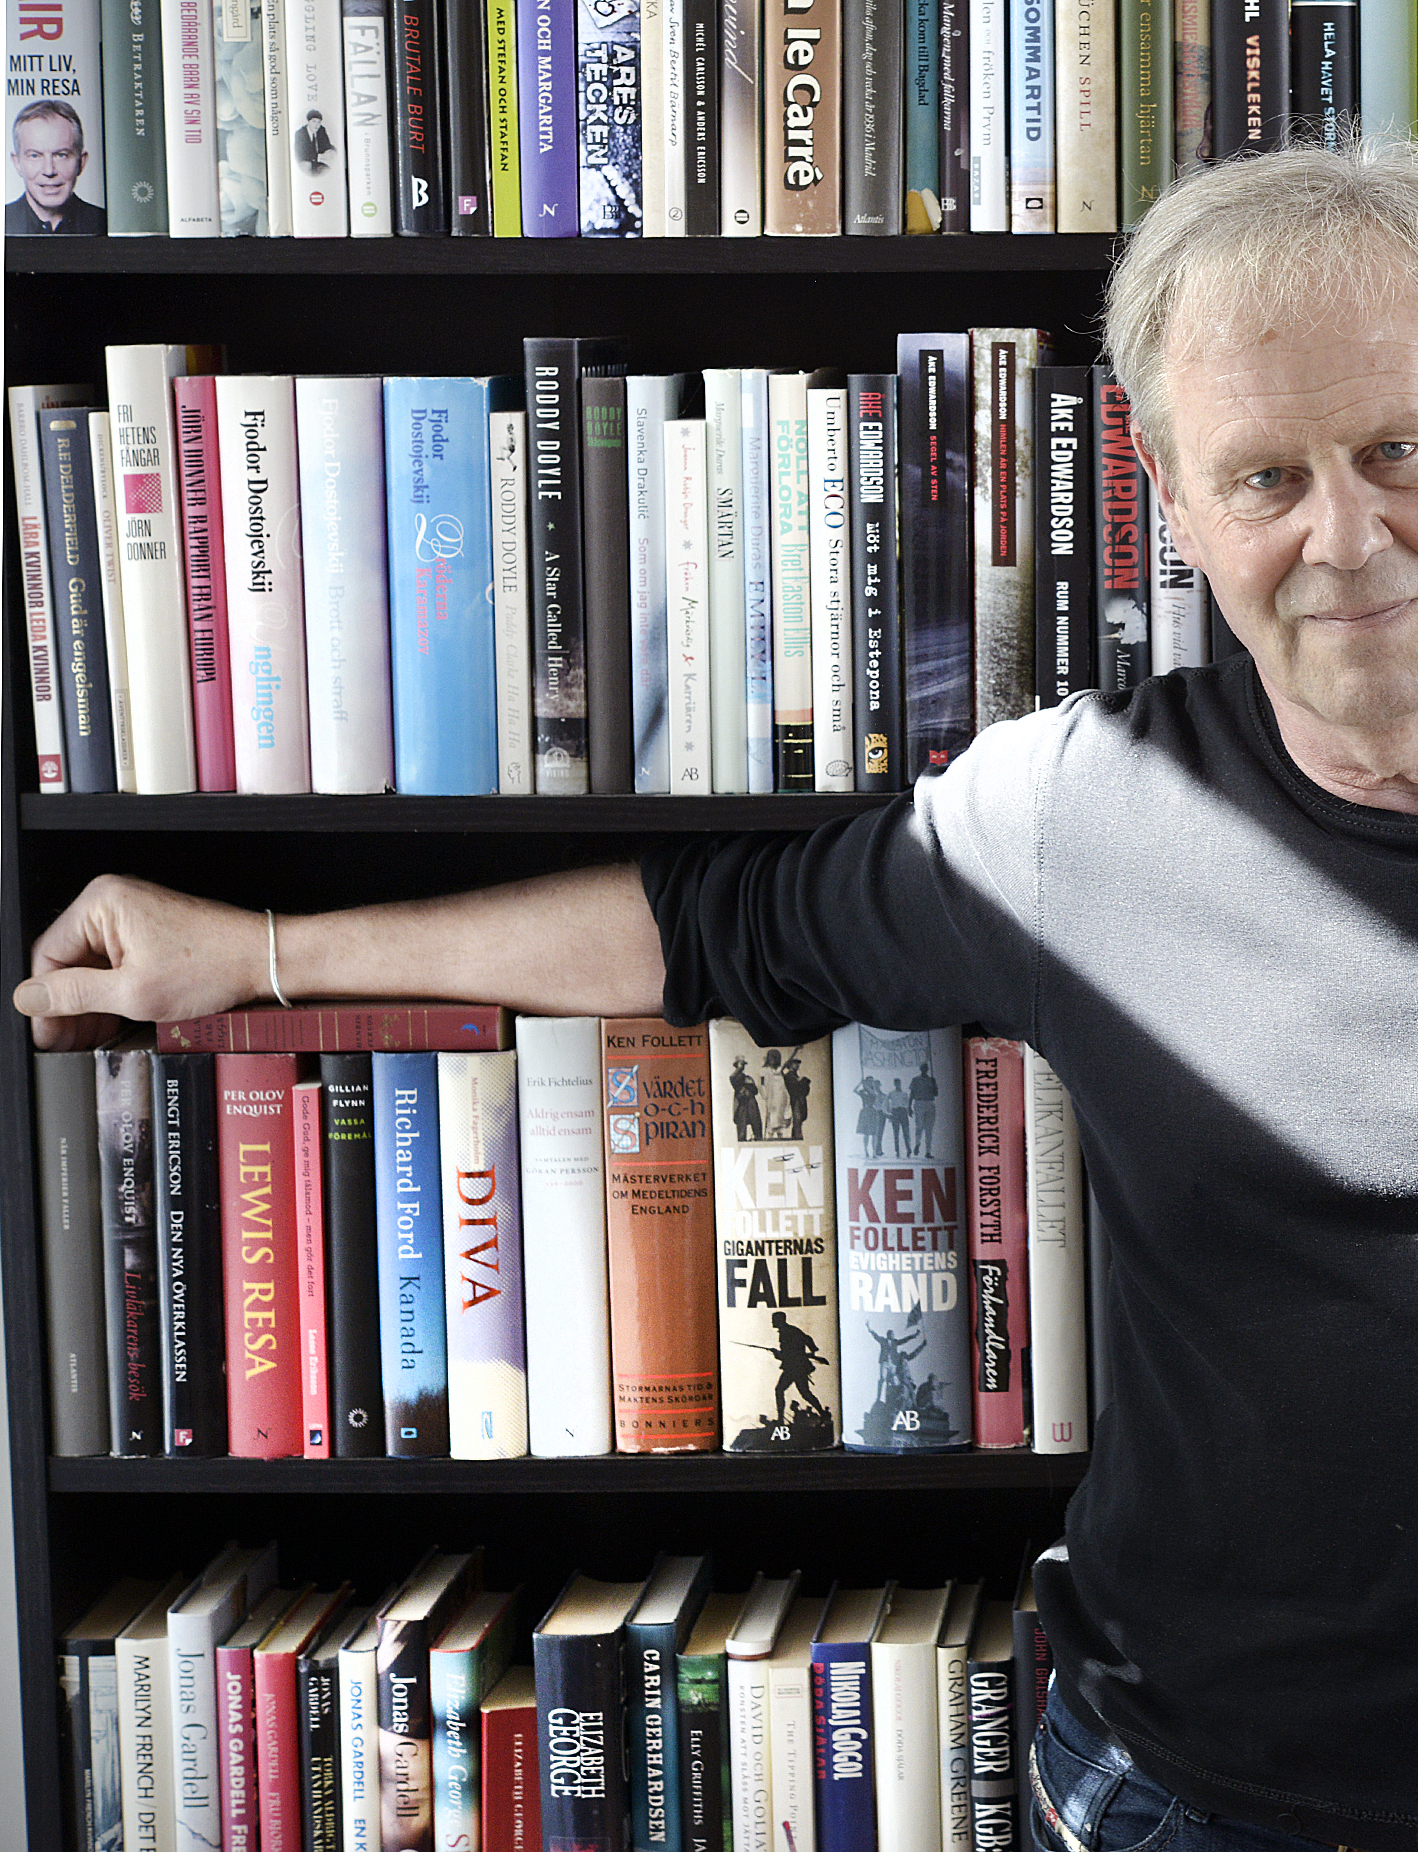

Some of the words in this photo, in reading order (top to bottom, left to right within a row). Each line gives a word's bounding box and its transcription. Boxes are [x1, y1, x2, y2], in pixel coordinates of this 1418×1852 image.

[496, 7, 505, 36] MED
[536, 18, 551, 51] OCH
[9, 54, 44, 72] MITT
[50, 54, 76, 74] LIV,
[347, 24, 382, 127] FÄLLAN
[403, 14, 422, 97] BRUTALE
[496, 38, 506, 84] STEFAN
[695, 56, 706, 96] CARLSSON
[785, 27, 822, 71] le
[1139, 12, 1151, 97] ensamma
[8, 79, 35, 96] MIN
[41, 79, 81, 96] RESA
[183, 92, 200, 107] AV
[498, 88, 507, 114] OCH
[537, 55, 553, 154] MARGARITA
[583, 42, 609, 167] TECKEN
[612, 44, 638, 125] ARES
[1079, 77, 1091, 131] SPILL
[1246, 34, 1262, 140] VISKLEKEN
[184, 109, 201, 126] SIN
[184, 129, 202, 144] TID
[407, 103, 425, 154] BURT
[499, 117, 509, 172] STAFFAN
[696, 110, 706, 141] ANDERS
[784, 73, 824, 192] Carré
[1136, 103, 1157, 166] hjärtan
[697, 146, 707, 184] ERICSSON
[117, 404, 133, 423] FRI
[534, 366, 560, 430] RODDY
[859, 391, 886, 418] ÅKE
[1050, 392, 1083, 433] ÅKE
[119, 426, 157, 445] HETENS
[120, 446, 161, 468] FÅNGAR
[239, 409, 266, 474] Fjodor
[409, 408, 431, 505] Dostojevskij
[430, 408, 450, 461] Fjodor
[824, 396, 842, 473] Umberto
[536, 440, 562, 500] DOYLE
[859, 421, 884, 504] EDWARDSON
[717, 487, 737, 559] SMÄRTAN
[823, 476, 845, 530] ECO
[1050, 437, 1078, 556] EDWARDSON
[21, 515, 42, 547] LÄRA
[126, 515, 152, 539] JÖRN
[127, 541, 167, 561] DONNER
[246, 477, 273, 594] Dostojevskij
[24, 551, 45, 609] KVINNOR
[544, 551, 561, 562] A
[544, 566, 561, 599] Star
[828, 538, 845, 585] Stora
[864, 563, 882, 598] mig
[68, 577, 88, 617] Gud
[415, 566, 430, 656] Karamazov
[868, 606, 882, 618] i
[1055, 581, 1069, 611] RUM
[29, 611, 48, 642] LEDA
[71, 618, 88, 637] är
[546, 603, 562, 652] Called
[825, 591, 843, 660] stjärnor
[1055, 615, 1070, 676] NUMMER
[32, 645, 52, 703] KVINNOR
[71, 640, 93, 738] engelsman
[546, 655, 564, 703] Henry
[830, 664, 846, 694] och
[865, 627, 882, 712] Estepona
[1056, 680, 1070, 697] 10
[831, 698, 846, 733] små
[607, 1036, 636, 1047] KEN
[642, 1034, 704, 1047] FOLLETT
[166, 1079, 179, 1127] BENGT
[223, 1090, 246, 1101] PER
[249, 1089, 284, 1101] OLOV
[226, 1103, 283, 1118] ENQUIST
[328, 1083, 369, 1093] GILLIAN
[332, 1098, 366, 1107] FLYNN
[975, 1057, 1000, 1157] FREDERICK
[328, 1130, 372, 1140] FÖREMÅL
[333, 1117, 366, 1126] VASSA
[394, 1088, 421, 1193] Richard
[167, 1131, 182, 1196] ERICSON
[611, 1171, 707, 1185] MÄSTERVERKET
[720, 1145, 825, 1210] KEN
[239, 1141, 275, 1265] LEWIS
[631, 1203, 690, 1216] ENGLAND
[847, 1166, 958, 1225] KEN
[978, 1165, 1003, 1244] FORSYTH
[170, 1210, 185, 1242] DEN
[396, 1200, 423, 1260] Ford
[456, 1163, 502, 1315] DIVA
[723, 1237, 825, 1257] GIGANTERNAS
[729, 1207, 825, 1239] FOLLETT
[848, 1225, 959, 1252] FOLLETT
[171, 1247, 185, 1278] NYA
[725, 1256, 827, 1308] FALL
[848, 1250, 959, 1272] EVIGHETENS
[848, 1271, 959, 1313] RAND
[172, 1281, 188, 1382] ÖVERKLASSEN
[241, 1279, 278, 1382] RESA
[399, 1275, 424, 1371] Kanada
[978, 1264, 1006, 1391] Förhandlaren
[133, 1654, 154, 1728] MARILYN
[177, 1648, 206, 1716] Jonas
[225, 1670, 245, 1733] JONAS
[389, 1672, 417, 1734] Jonas
[643, 1648, 663, 1709] CARIN
[827, 1660, 866, 1727] NIKOLAJ
[947, 1659, 967, 1751] GRAHAM
[969, 1671, 1011, 1775] GRANGER
[135, 1733, 156, 1800] FRENCH
[179, 1722, 210, 1809] Gardell
[227, 1736, 247, 1818] GARDELL
[393, 1741, 421, 1818] Gardell
[547, 1707, 582, 1799] GEORGE
[579, 1710, 606, 1799] ELIZABETH
[645, 1713, 666, 1844] GERHARDSEN
[831, 1728, 869, 1781] GOGOL
[949, 1757, 970, 1844] GREENE
